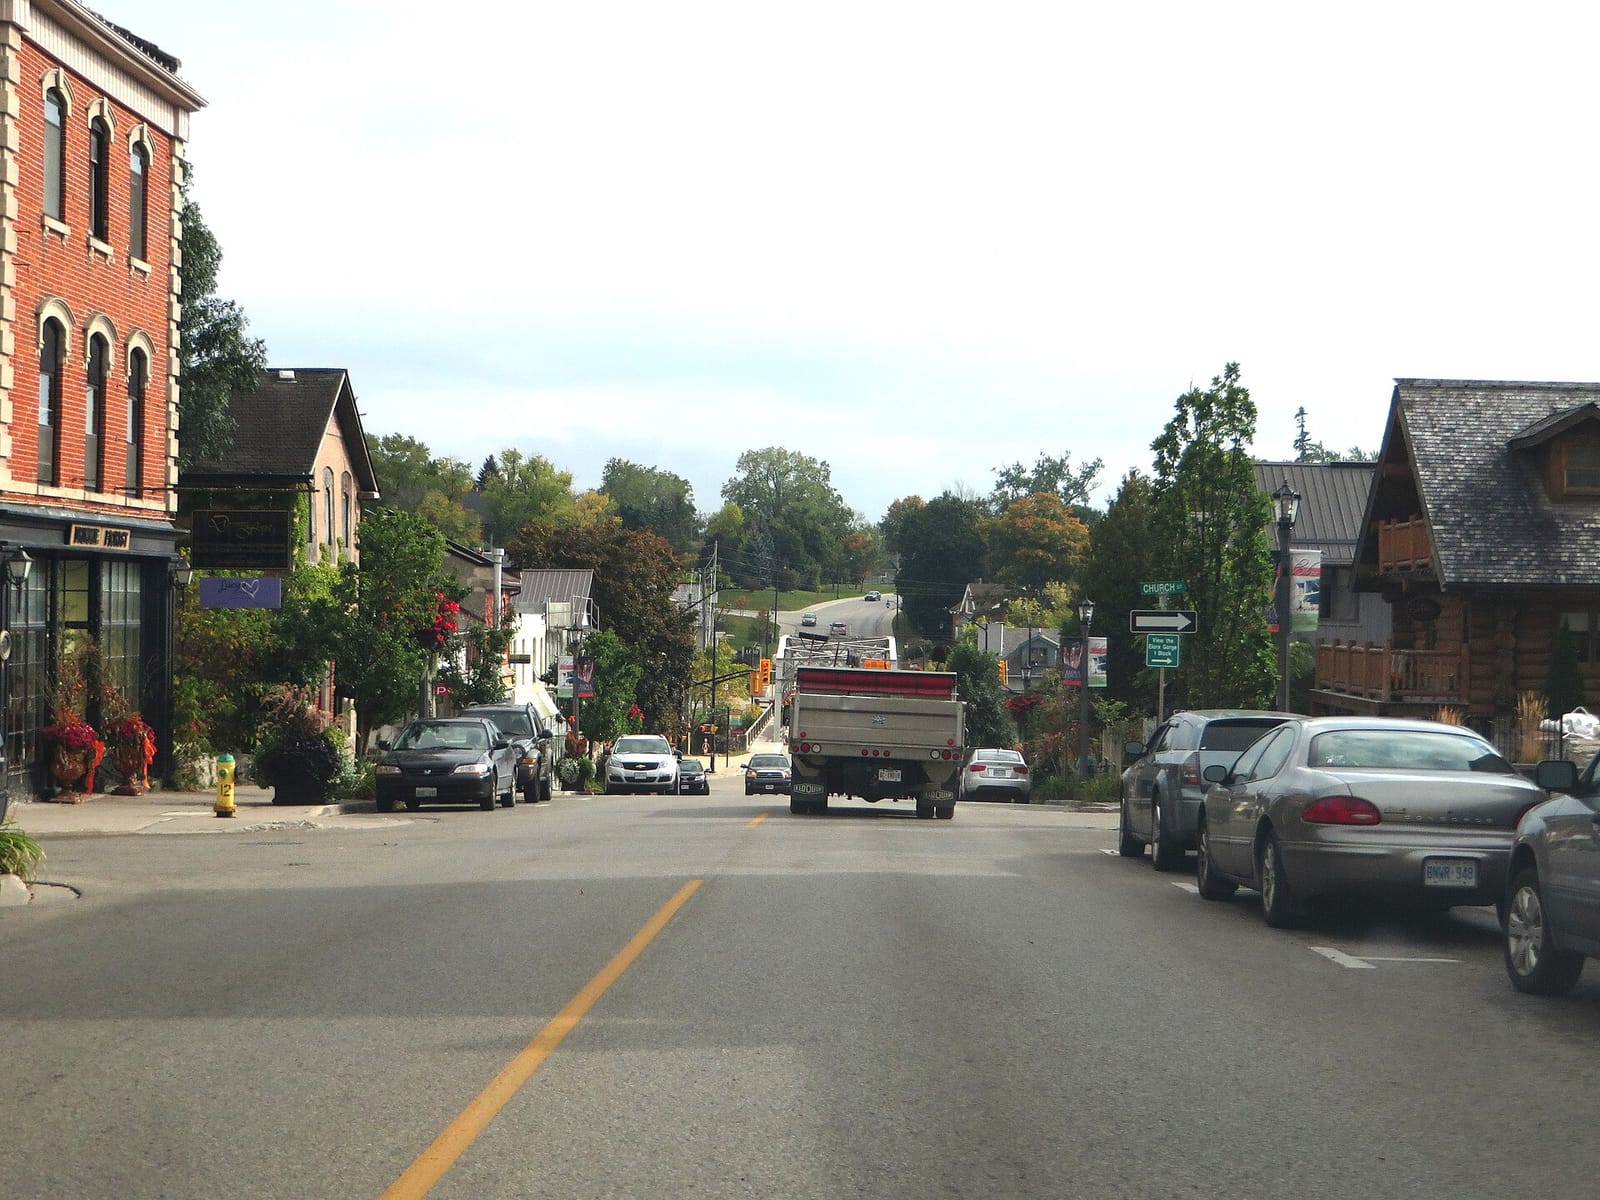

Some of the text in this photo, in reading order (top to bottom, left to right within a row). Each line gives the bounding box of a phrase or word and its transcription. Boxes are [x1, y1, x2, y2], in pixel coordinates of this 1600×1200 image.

[1143, 583, 1175, 593] CHURCH
[220, 783, 231, 797] 12
[1455, 866, 1473, 880] 948
